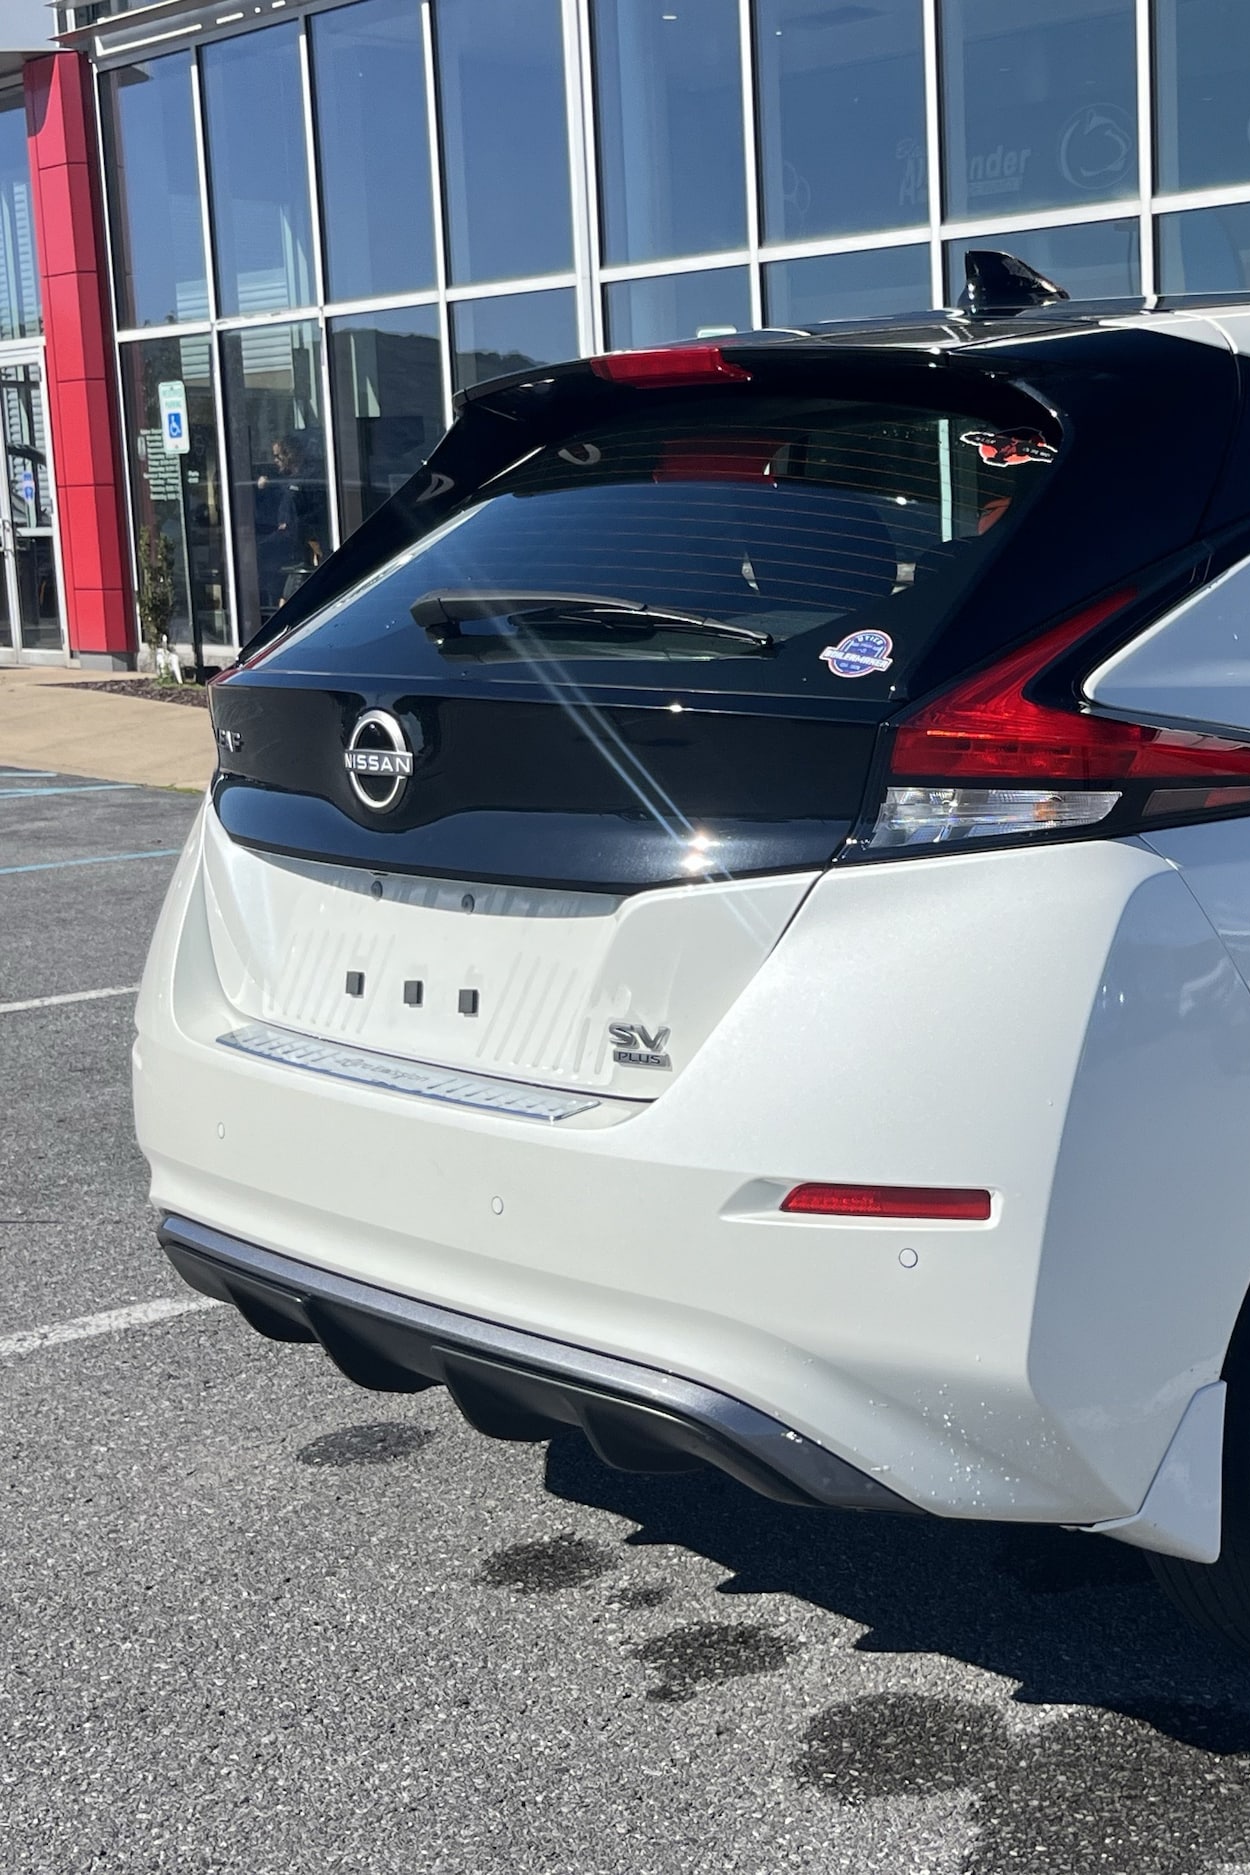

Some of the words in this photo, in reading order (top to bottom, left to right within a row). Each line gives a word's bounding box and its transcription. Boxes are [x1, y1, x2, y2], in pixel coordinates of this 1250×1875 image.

[345, 752, 411, 773] NISSAN
[608, 1023, 671, 1050] SV
[618, 1051, 661, 1065] PLUS
